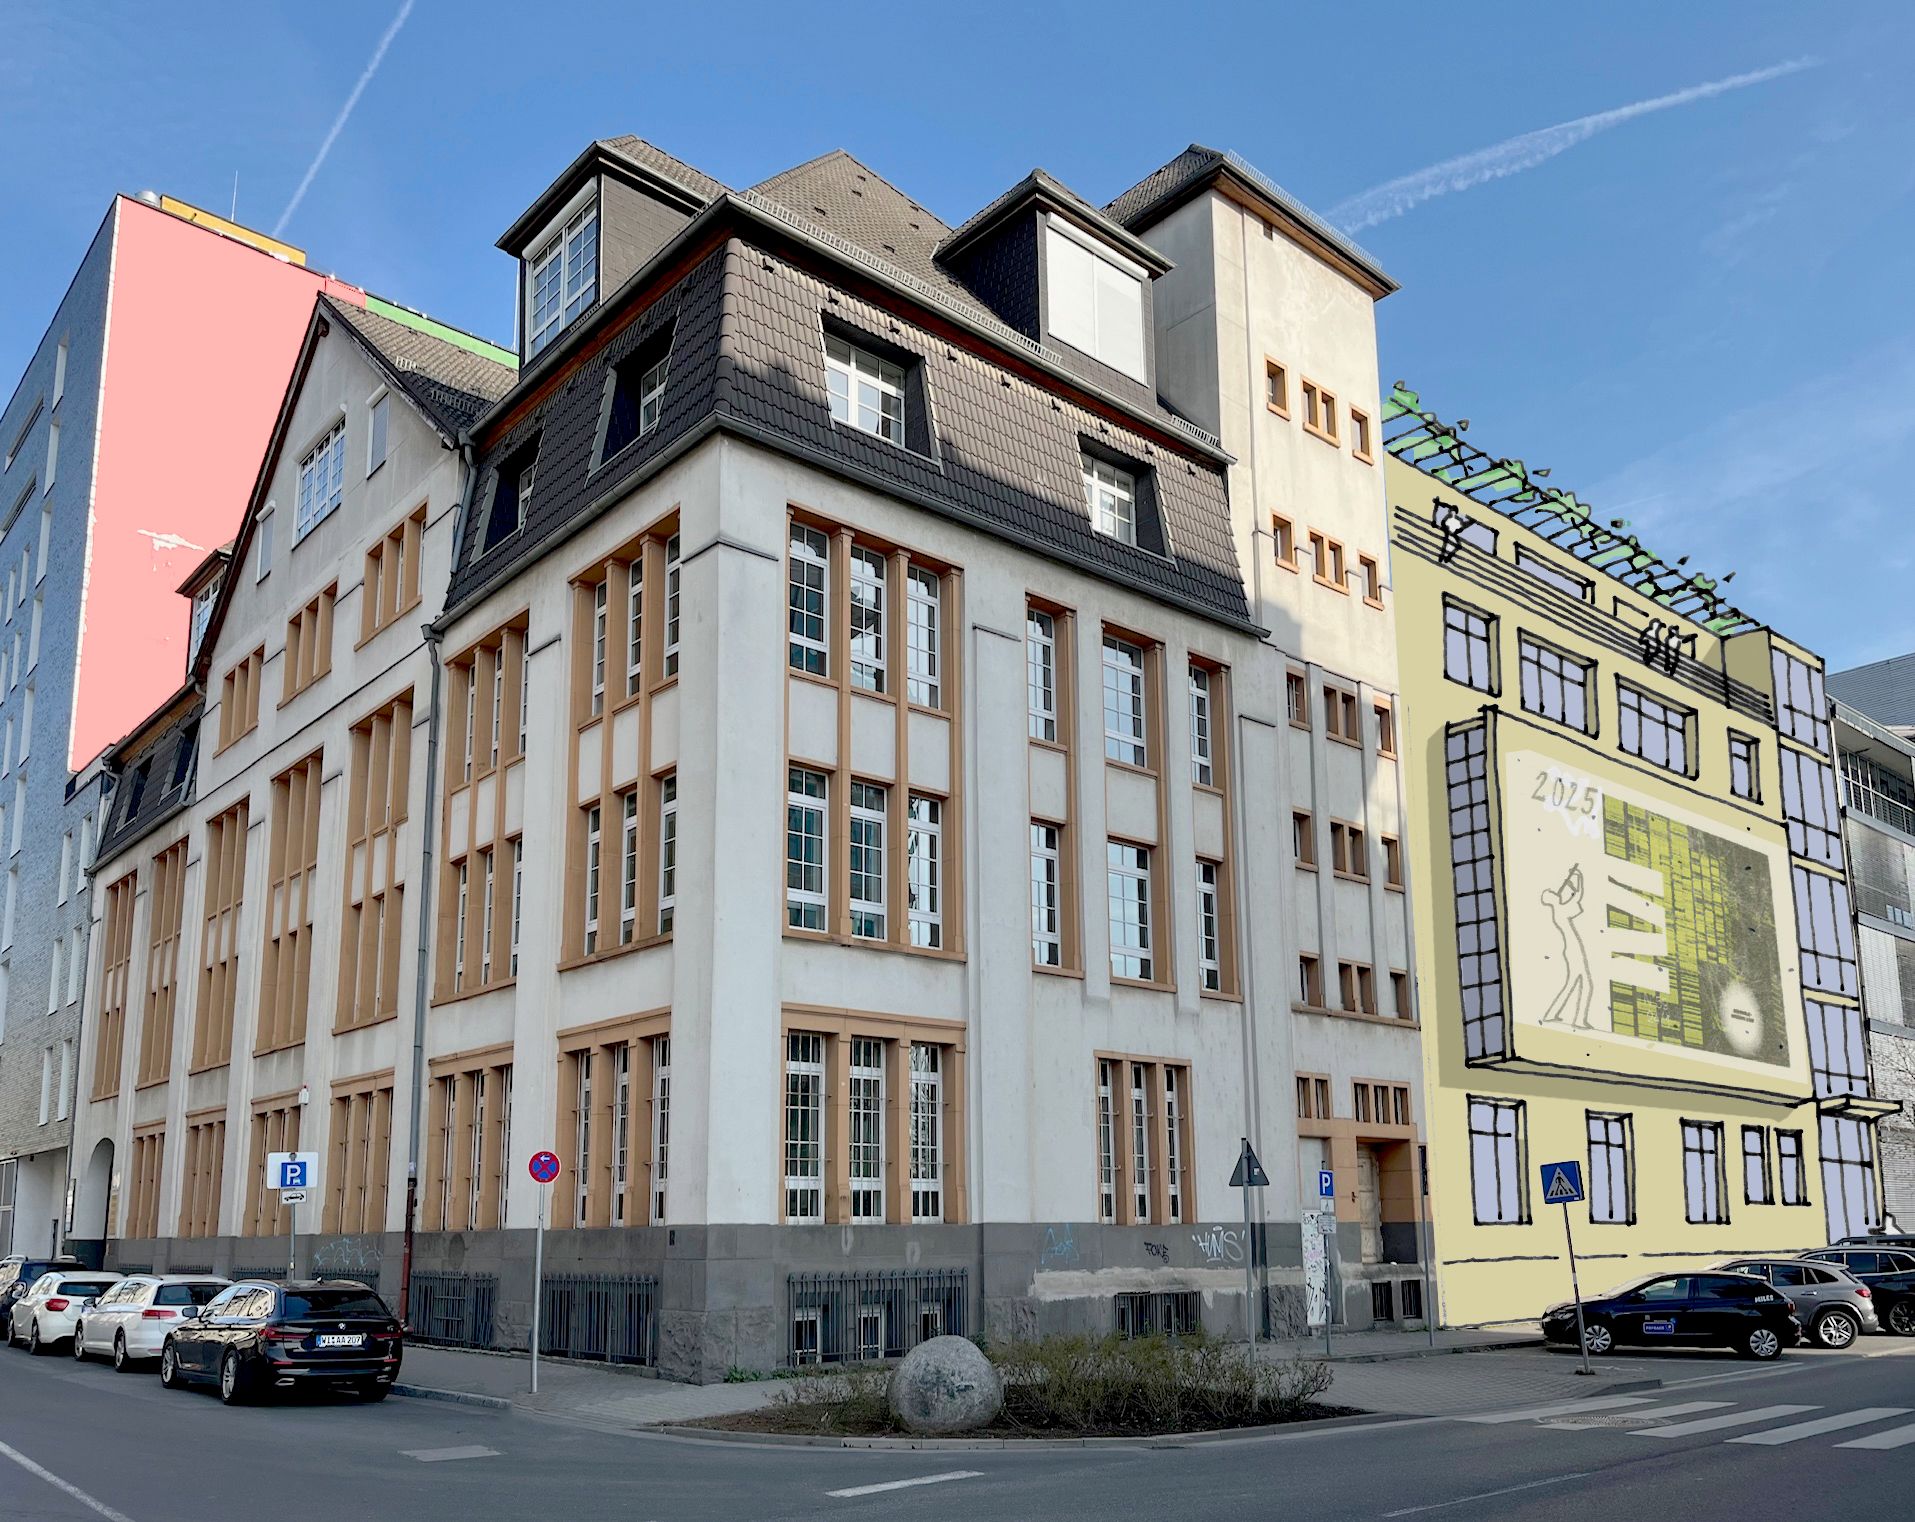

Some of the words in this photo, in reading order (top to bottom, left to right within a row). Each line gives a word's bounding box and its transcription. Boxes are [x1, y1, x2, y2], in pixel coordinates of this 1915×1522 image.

[1531, 770, 1598, 815] 2025
[286, 1164, 301, 1186] P
[1321, 1173, 1331, 1194] P
[1754, 1294, 1774, 1303] MILES
